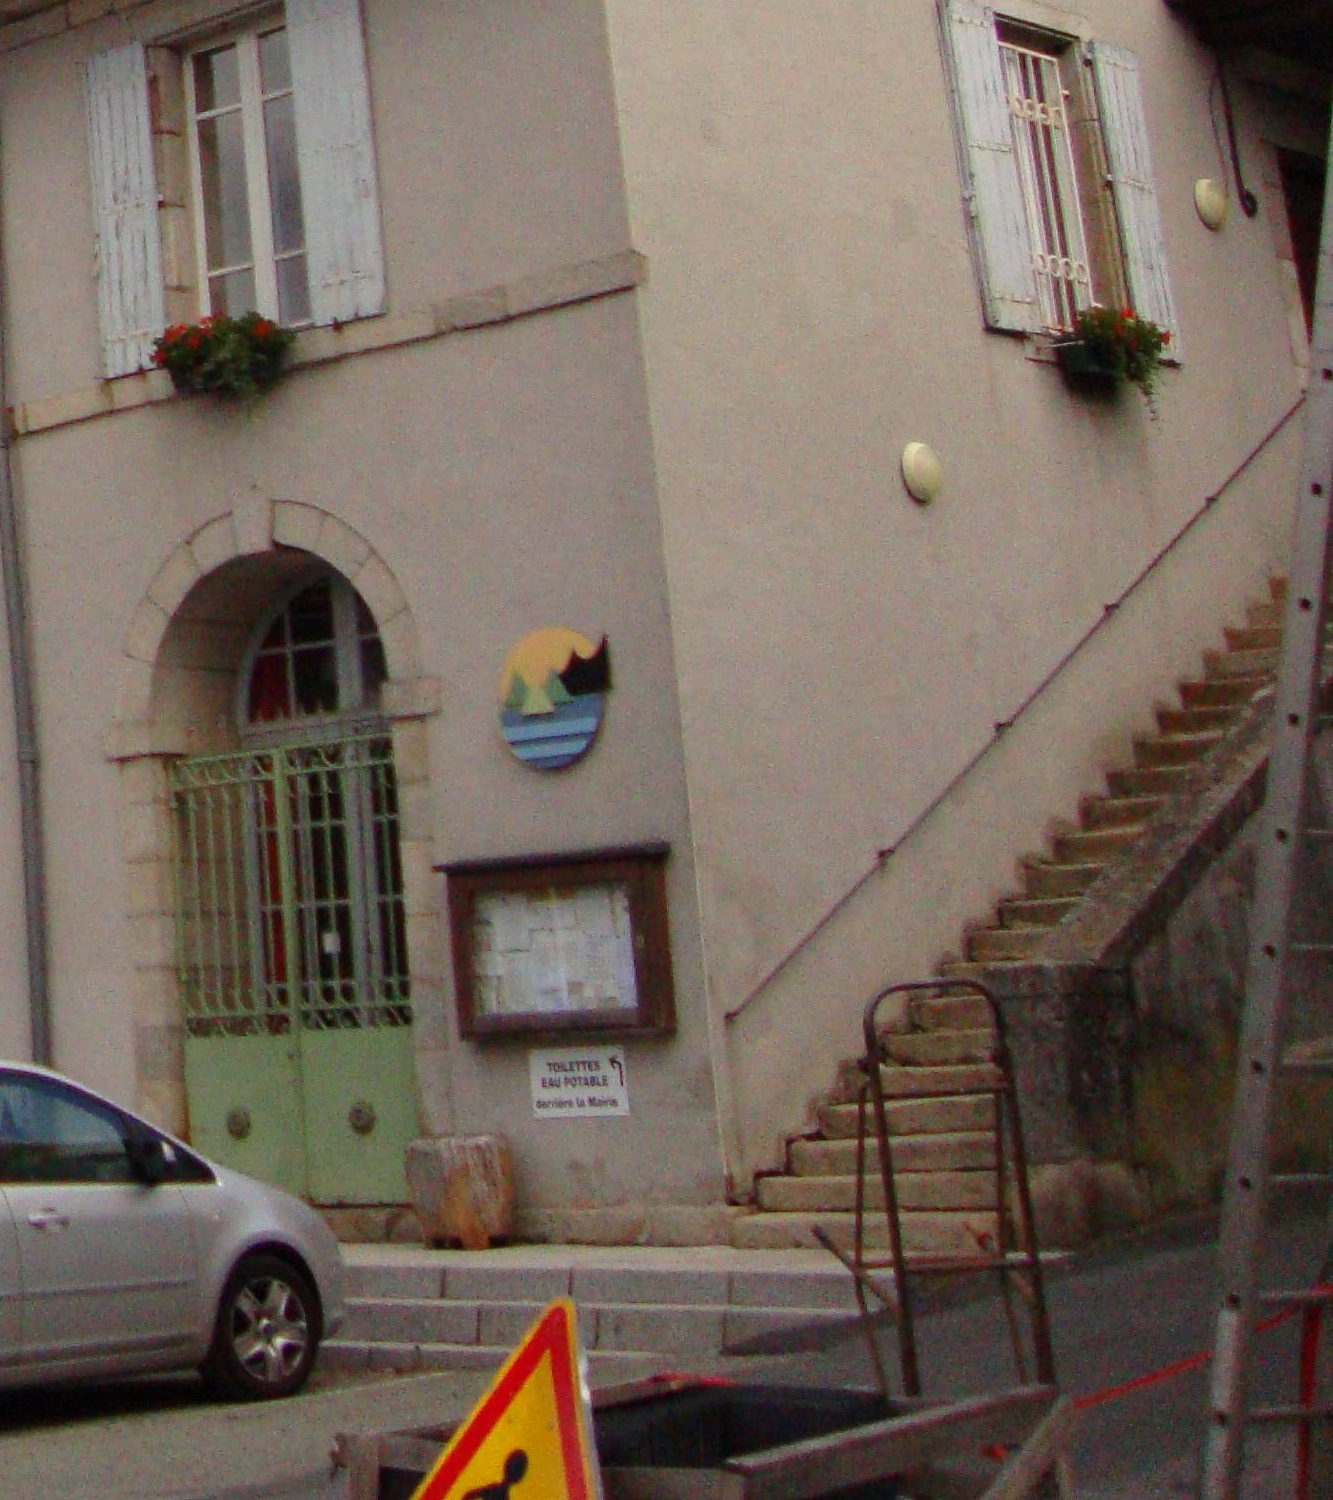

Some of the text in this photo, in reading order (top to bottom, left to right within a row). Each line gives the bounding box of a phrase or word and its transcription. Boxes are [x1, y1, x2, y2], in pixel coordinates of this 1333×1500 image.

[546, 1060, 601, 1073] TOILETTES
[541, 1075, 608, 1088] EAU POTABLE
